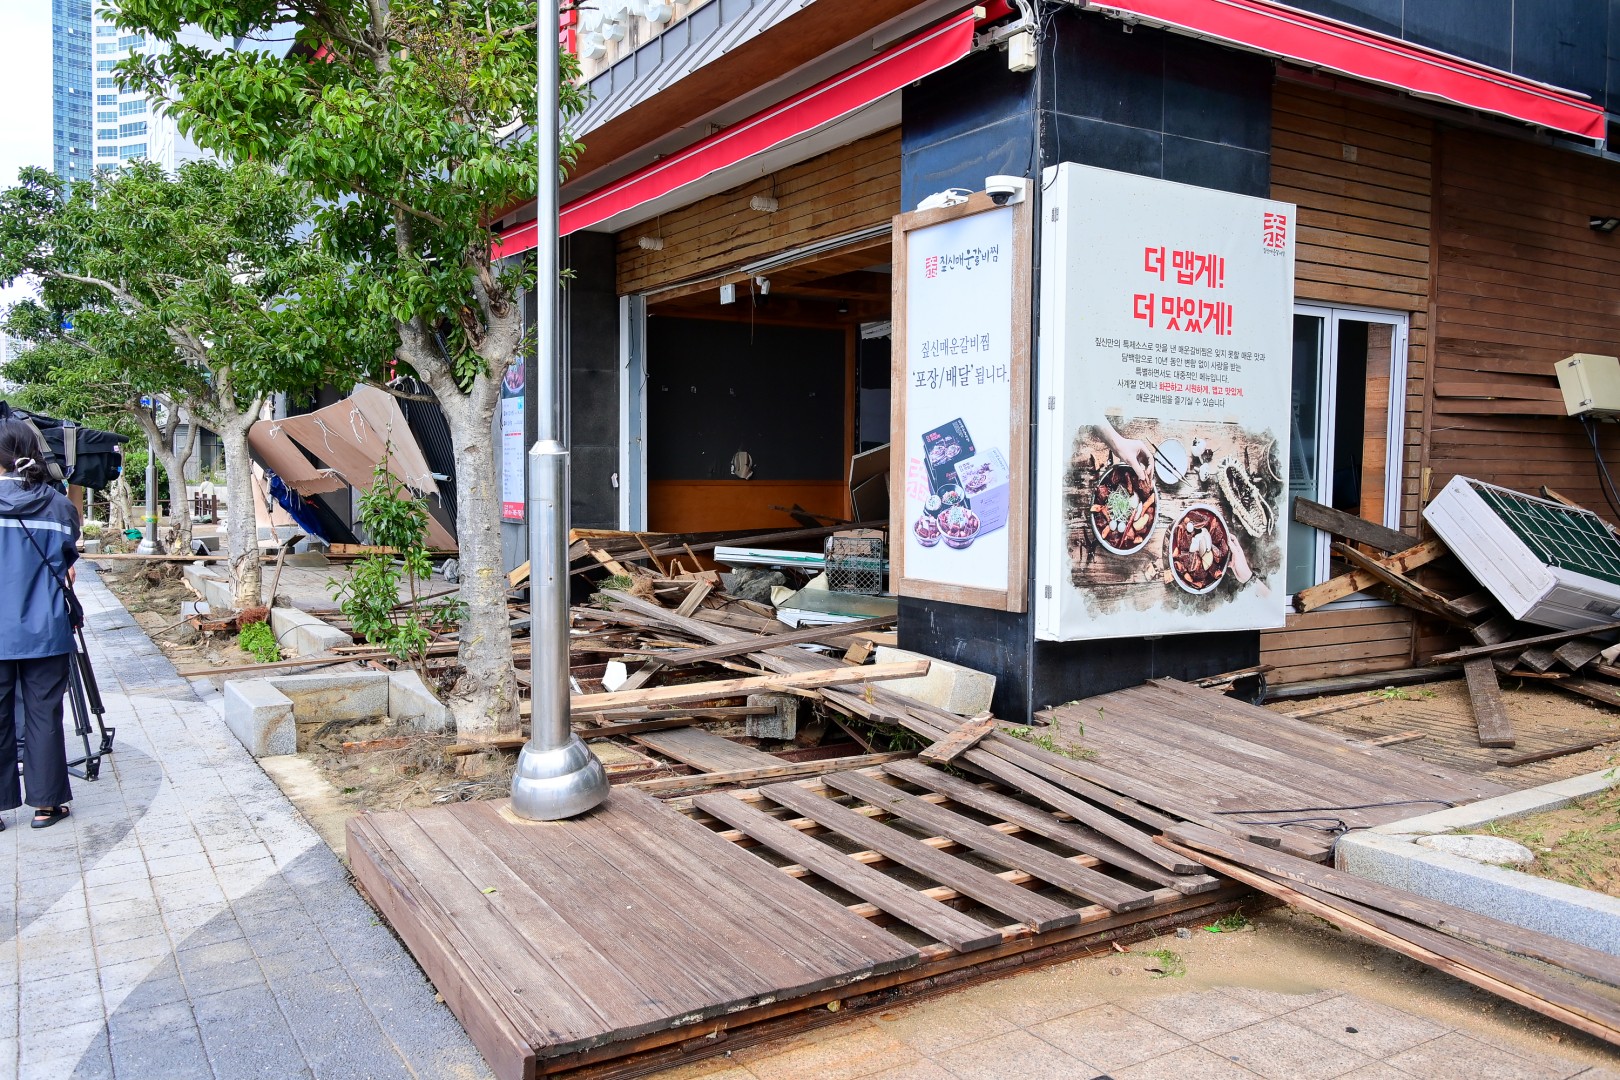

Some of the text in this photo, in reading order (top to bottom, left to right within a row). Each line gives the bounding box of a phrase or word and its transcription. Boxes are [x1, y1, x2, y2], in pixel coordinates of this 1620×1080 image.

[1144, 246, 1225, 289] 더 맵게!
[1133, 292, 1233, 336] 더 맛있게!
[921, 332, 990, 359] 짚신매운갈비찜
[1095, 337, 1266, 362] 짚신만의 특제소스로 맛을 낸 매운갈비찜은 잊지 못할 매운 맛과
[1121, 353, 1241, 372] 담백함으로 10년 동안 변함 없이 사랑을 받는
[1135, 366, 1172, 378] 특별하면서도
[1173, 371, 1198, 381] 대중적인
[1117, 379, 1137, 389] 사계절
[1138, 380, 1158, 390] 언제나
[1159, 381, 1183, 392] 화끈하고
[1212, 386, 1224, 396] 맵고
[1136, 393, 1225, 408] 매운갈비찜을 즐기실 수 있습니다
